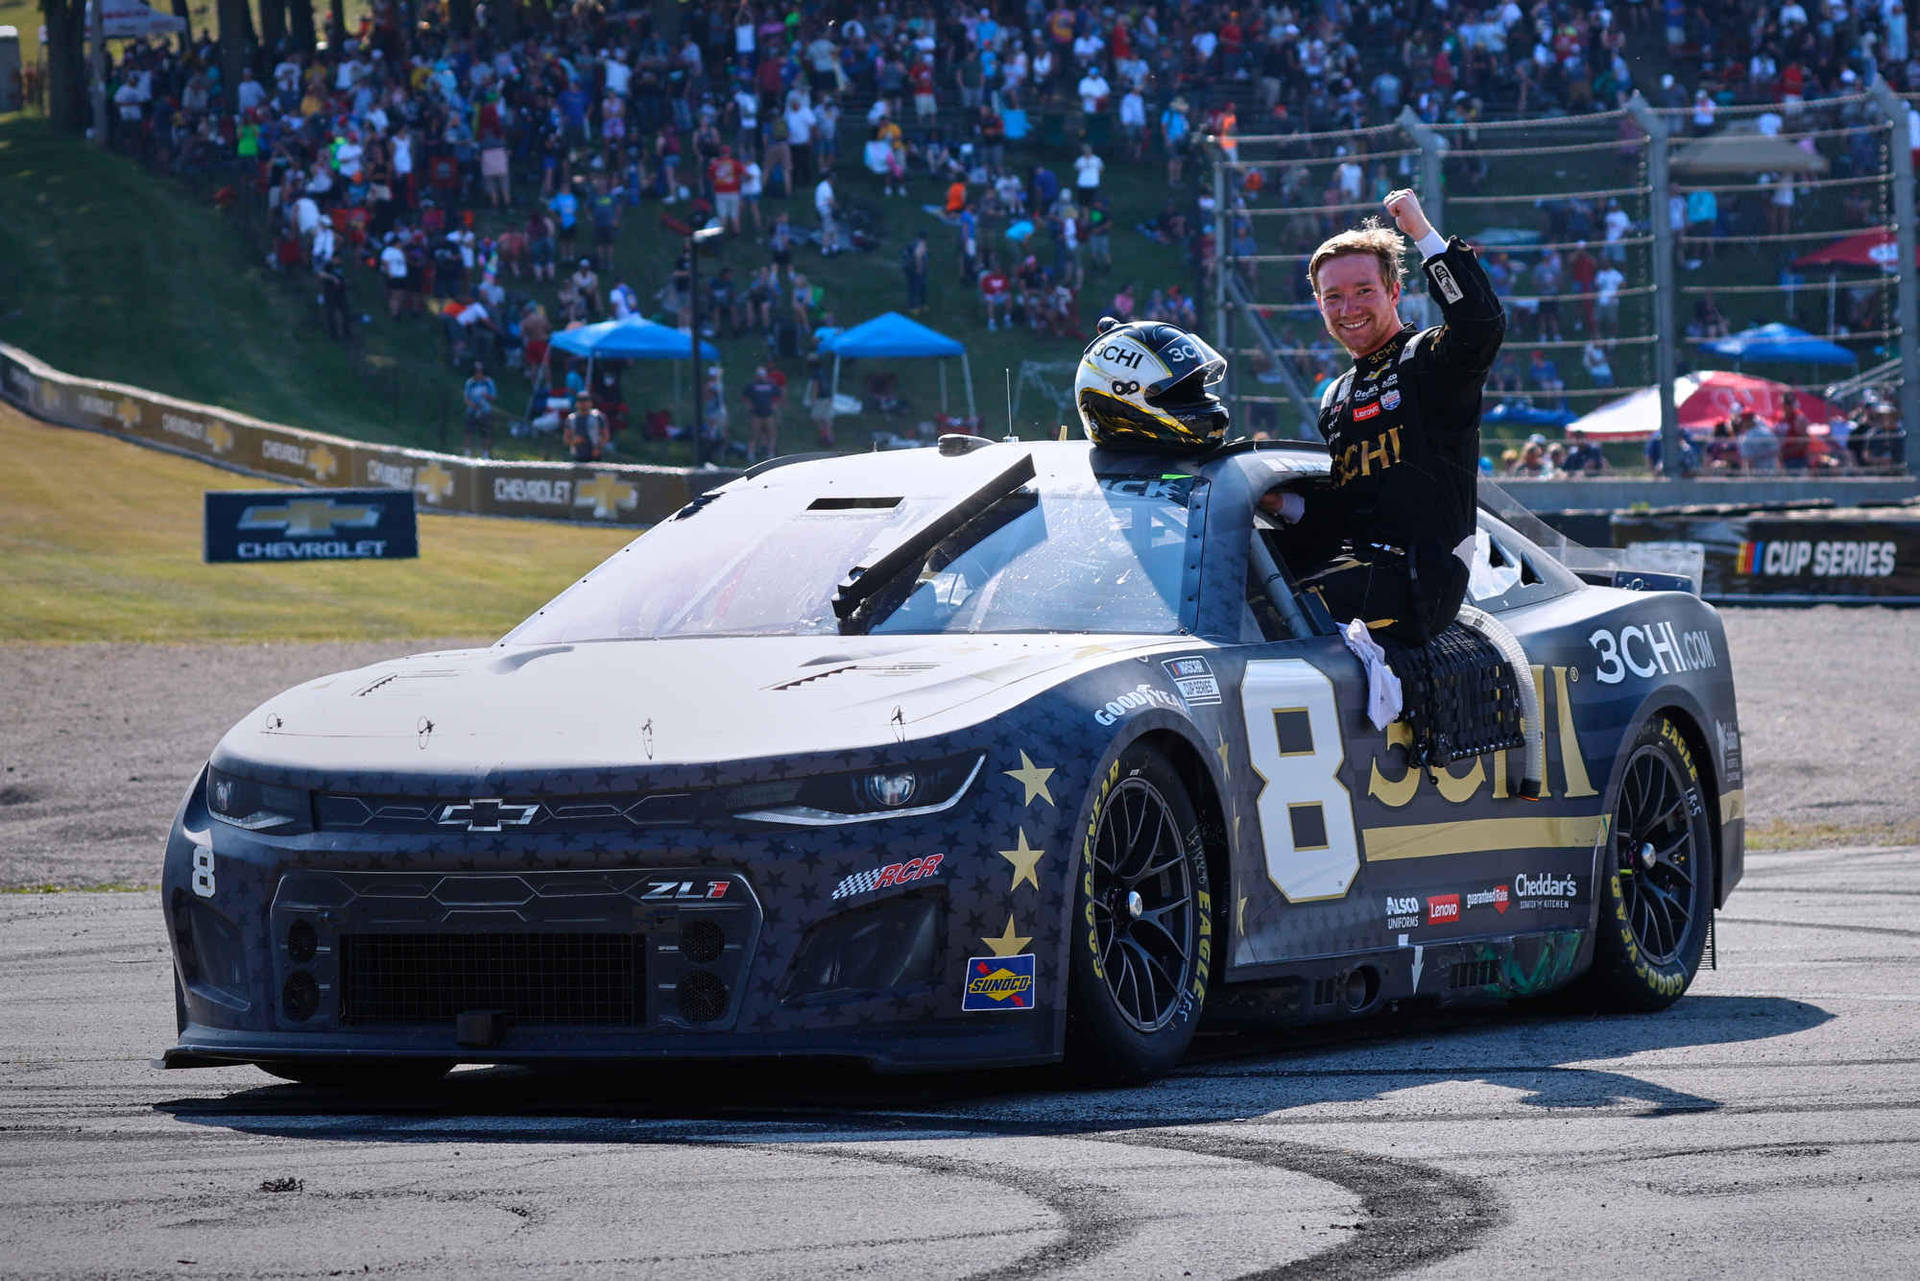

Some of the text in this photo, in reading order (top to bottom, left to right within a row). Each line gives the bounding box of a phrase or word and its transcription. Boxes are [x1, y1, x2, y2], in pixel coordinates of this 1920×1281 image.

[1094, 342, 1143, 369] 3CHI
[493, 477, 571, 503] CHEVROLET
[237, 540, 387, 558] CHEVROLET
[1763, 541, 1897, 576] CUP SERIES
[1661, 717, 1698, 782] EAGLE
[1240, 658, 1360, 903] 8
[191, 844, 215, 898] 8
[875, 852, 944, 890] RCR
[640, 881, 730, 900] ZL1
[1514, 873, 1577, 897] Cheddar's
[1387, 914, 1419, 929] UNIFORMS
[1430, 903, 1457, 918] Lenovo
[1192, 889, 1212, 1013] EAGLE
[968, 975, 1032, 994] SUNOCO
